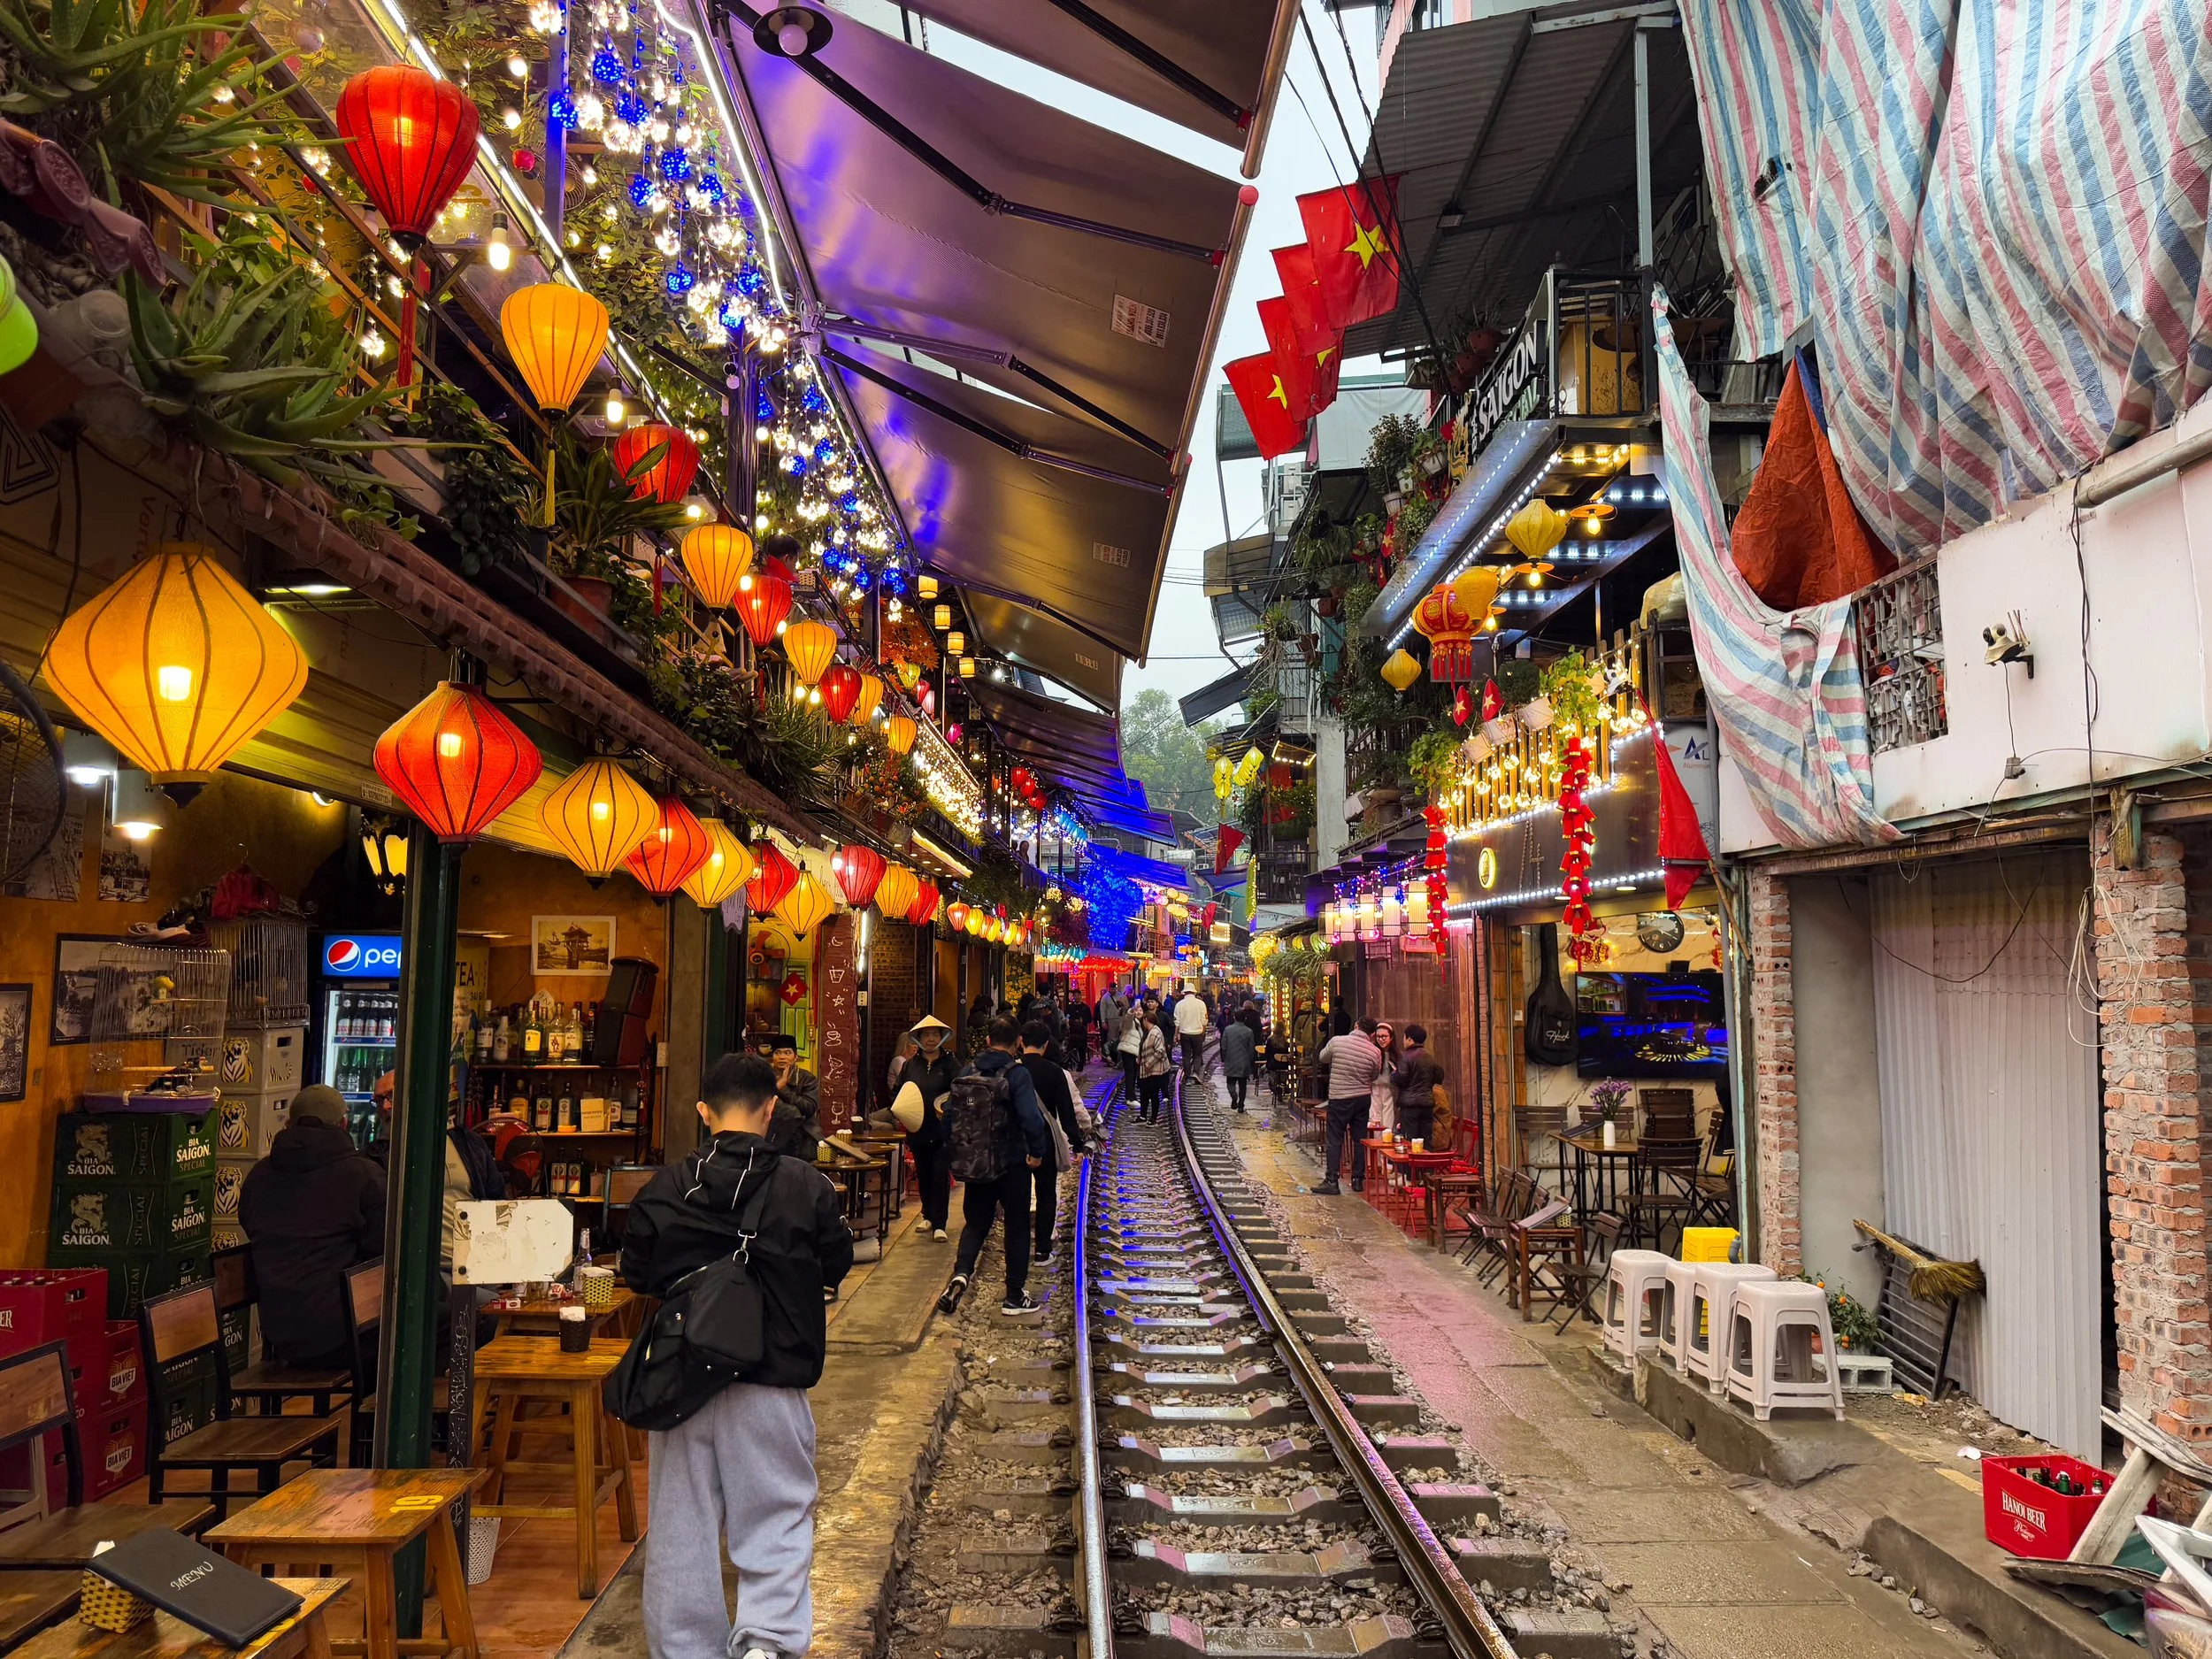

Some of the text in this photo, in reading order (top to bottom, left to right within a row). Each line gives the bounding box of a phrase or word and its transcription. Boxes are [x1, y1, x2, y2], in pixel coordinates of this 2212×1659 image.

[1479, 319, 1538, 442] SAIGON
[136, 496, 157, 556] Vert
[139, 1126, 149, 1175] SPECIAL
[176, 1143, 210, 1163] SAIGON
[188, 1138, 199, 1148] BIA
[67, 1164, 114, 1175] SAIGON
[179, 1159, 205, 1172] SPECIAL
[134, 1196, 145, 1246] SPECIAL
[183, 1206, 195, 1217] BIA
[171, 1211, 205, 1233] SAIGON
[62, 1234, 110, 1246] SAIGON
[180, 1275, 191, 1285] BIA
[111, 1373, 122, 1388] BIA
[165, 1418, 194, 1442] AIGON
[171, 1416, 182, 1427] BIA
[107, 1455, 118, 1468] BIA
[389, 1494, 444, 1514] 19
[2001, 1490, 2047, 1533] HANOI BEER
[170, 1561, 214, 1591] MENU
